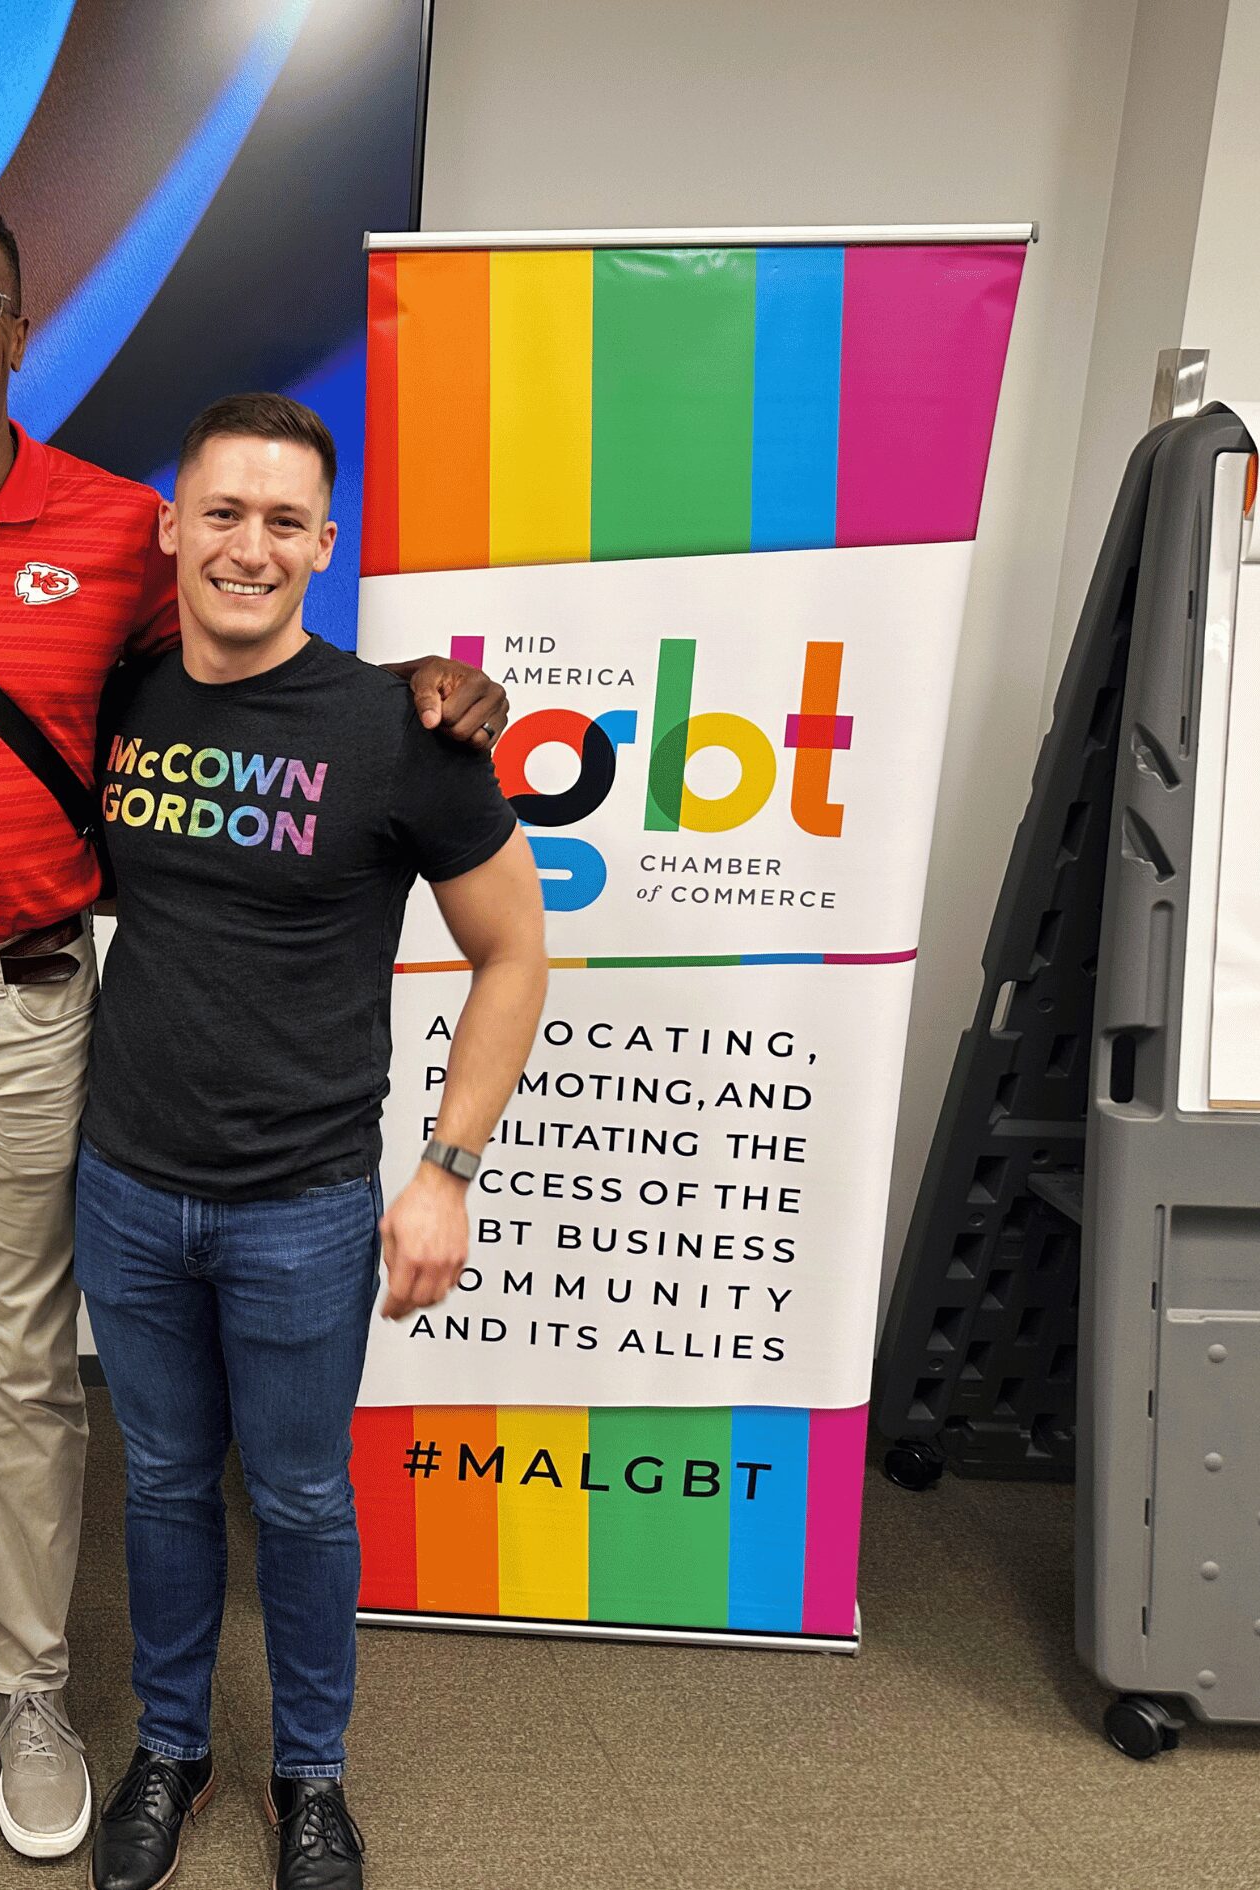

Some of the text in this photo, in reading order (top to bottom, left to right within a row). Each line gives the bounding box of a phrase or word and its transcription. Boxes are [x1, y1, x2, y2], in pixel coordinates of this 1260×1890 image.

[30, 571, 70, 596] KC
[505, 636, 556, 654] MID
[502, 667, 636, 686] AMERICA
[106, 734, 328, 803] McCOWN
[102, 783, 317, 856] GORDON
[639, 854, 782, 876] CHAMBER
[636, 884, 837, 909] of COMMERCE
[425, 1015, 817, 1065] AOCATING,
[425, 1066, 813, 1111] PMOTING, AND
[422, 1116, 808, 1163] FILITATING THE
[478, 1168, 802, 1214] CCESS OF THE
[557, 1224, 796, 1263] BUSINESS
[457, 1267, 793, 1313] OMMUNITY
[409, 1314, 785, 1362] AND ITS ALLIES
[402, 1440, 772, 1500] #MALGBT
